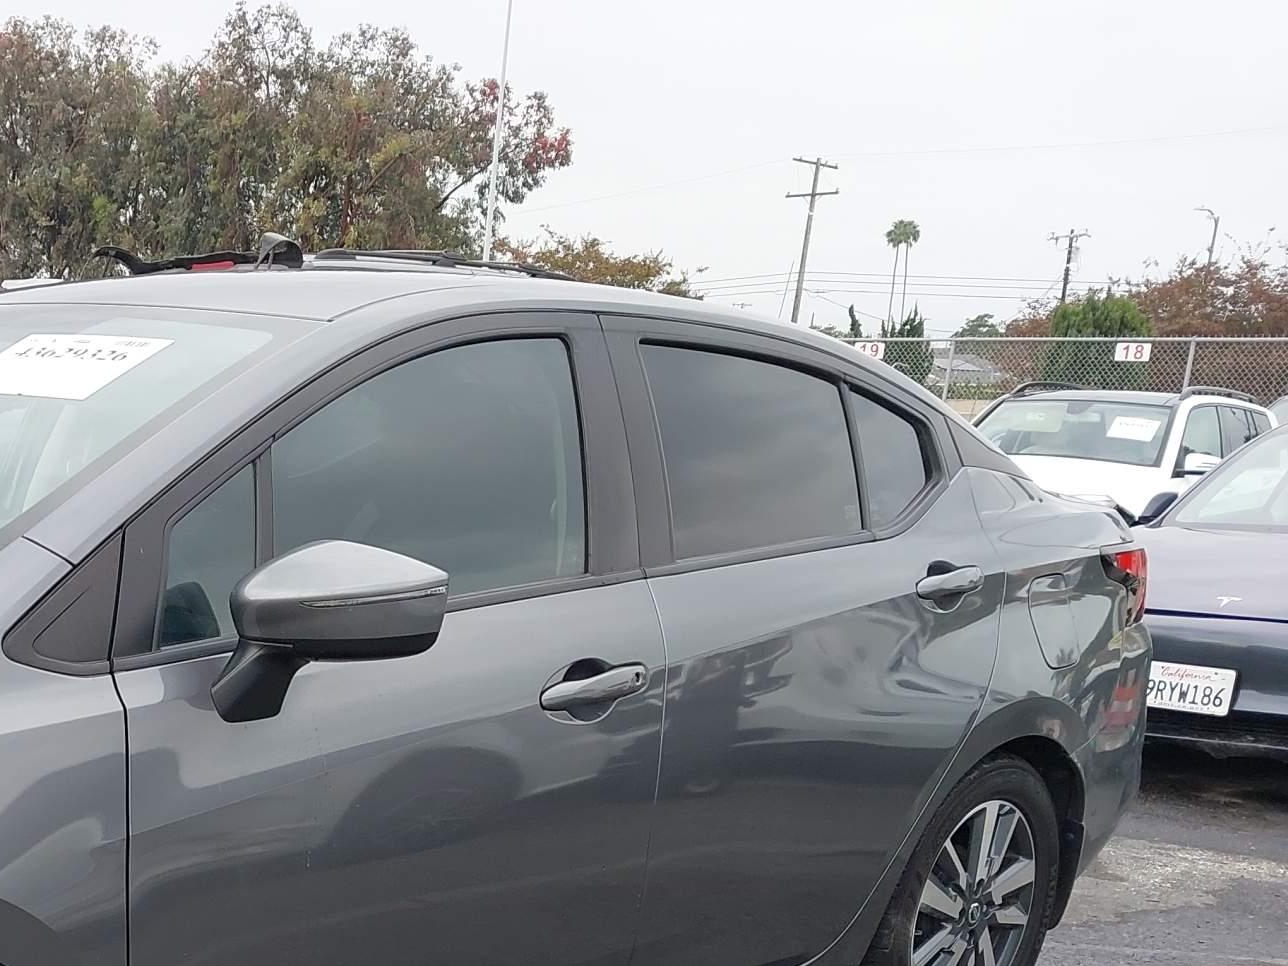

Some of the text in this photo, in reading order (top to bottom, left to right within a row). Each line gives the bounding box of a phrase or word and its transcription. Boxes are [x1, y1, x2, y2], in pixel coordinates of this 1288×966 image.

[859, 343, 880, 358] 19
[1122, 343, 1145, 360] 18
[1161, 667, 1214, 681] California
[1145, 679, 1226, 708] 9RYW186
